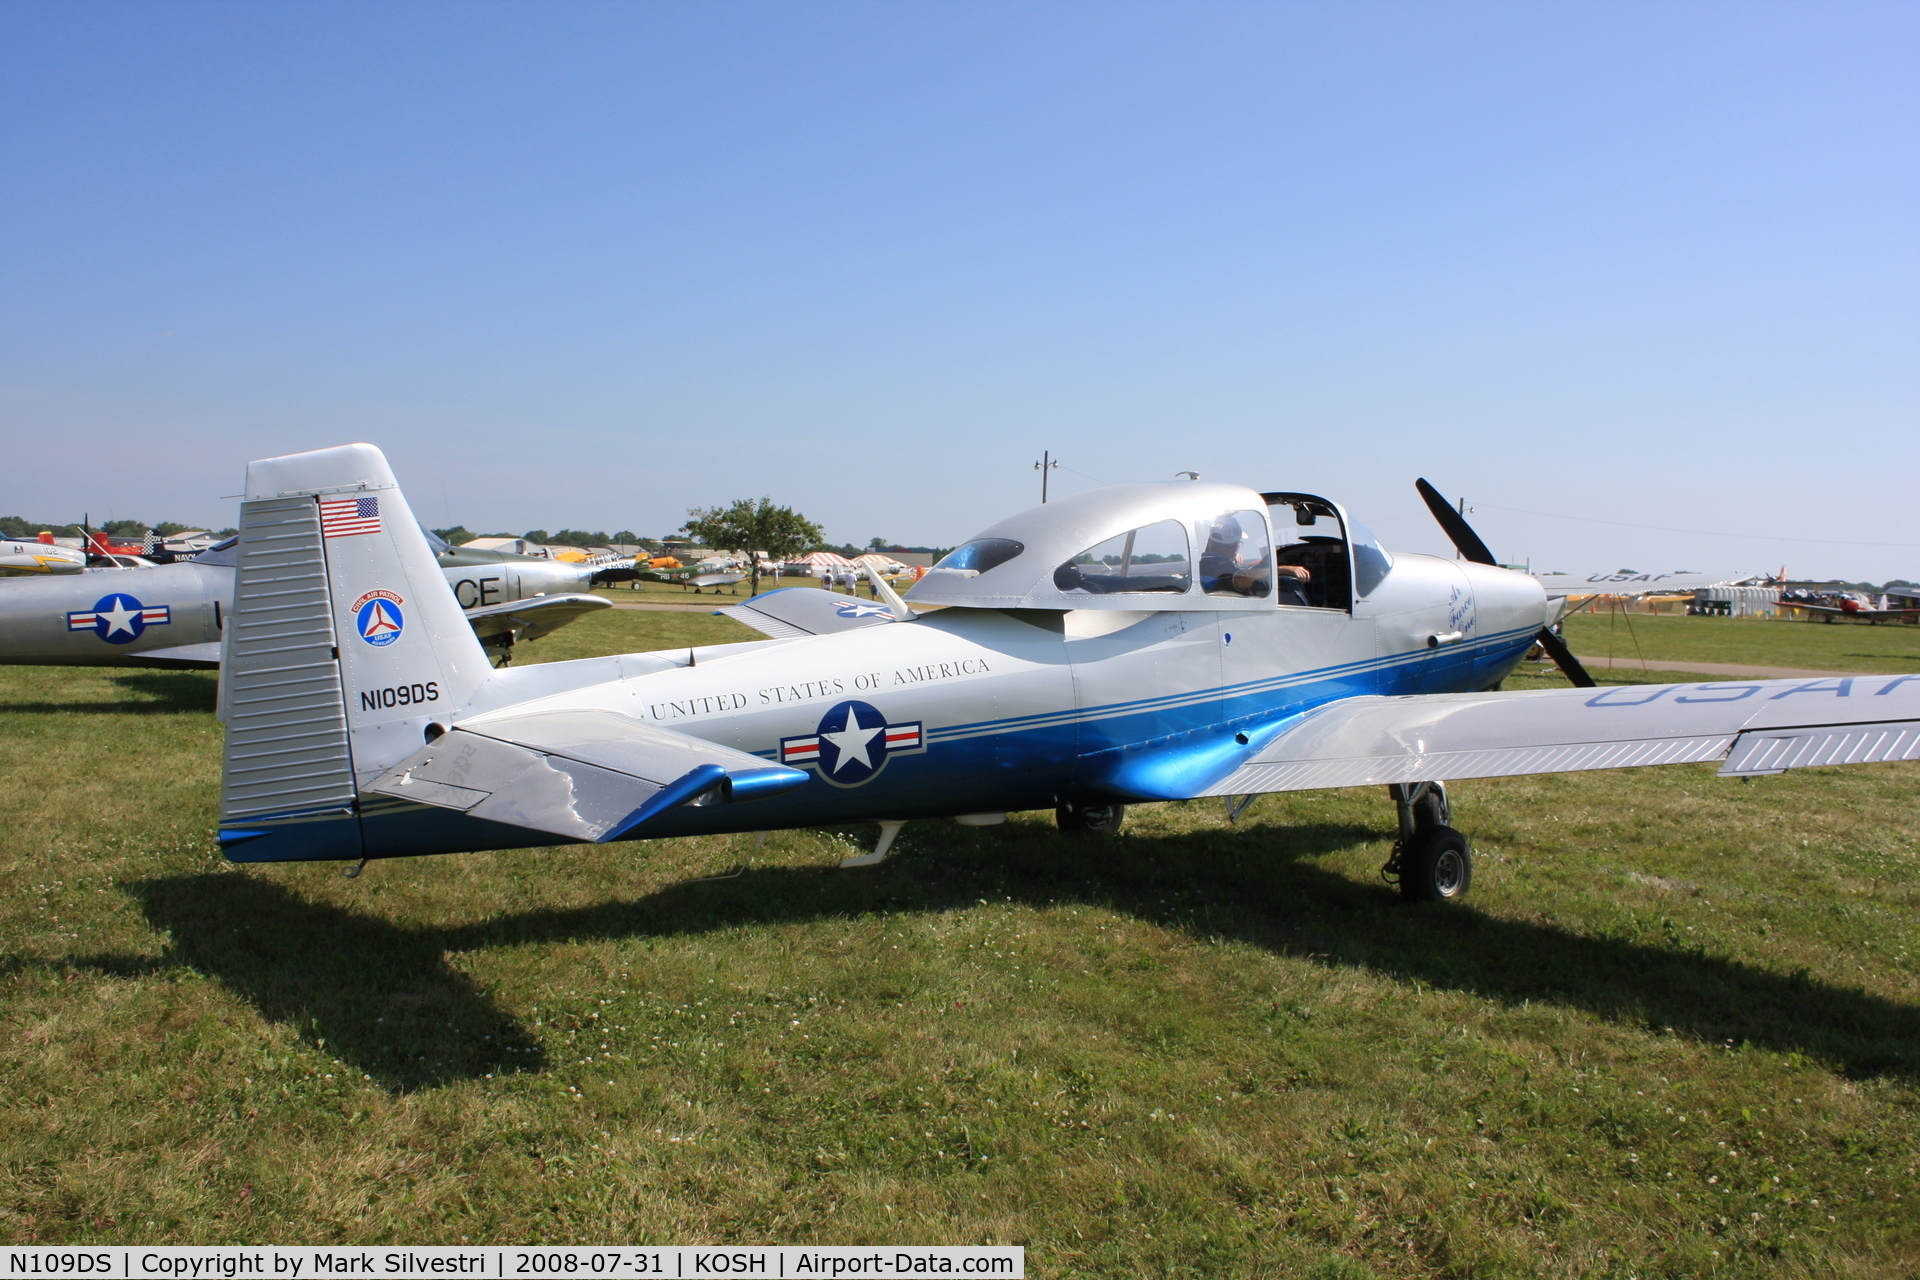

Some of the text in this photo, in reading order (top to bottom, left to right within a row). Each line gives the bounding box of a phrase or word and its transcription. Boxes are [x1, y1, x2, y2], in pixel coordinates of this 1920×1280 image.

[174, 553, 196, 562] NAVY
[1586, 573, 1672, 582] USAF
[353, 590, 402, 611] CIVIL AIR PATROL
[374, 632, 392, 641] USAF
[361, 681, 439, 711] N109DS
[650, 658, 990, 721] UNITED STATES OF AMERICA
